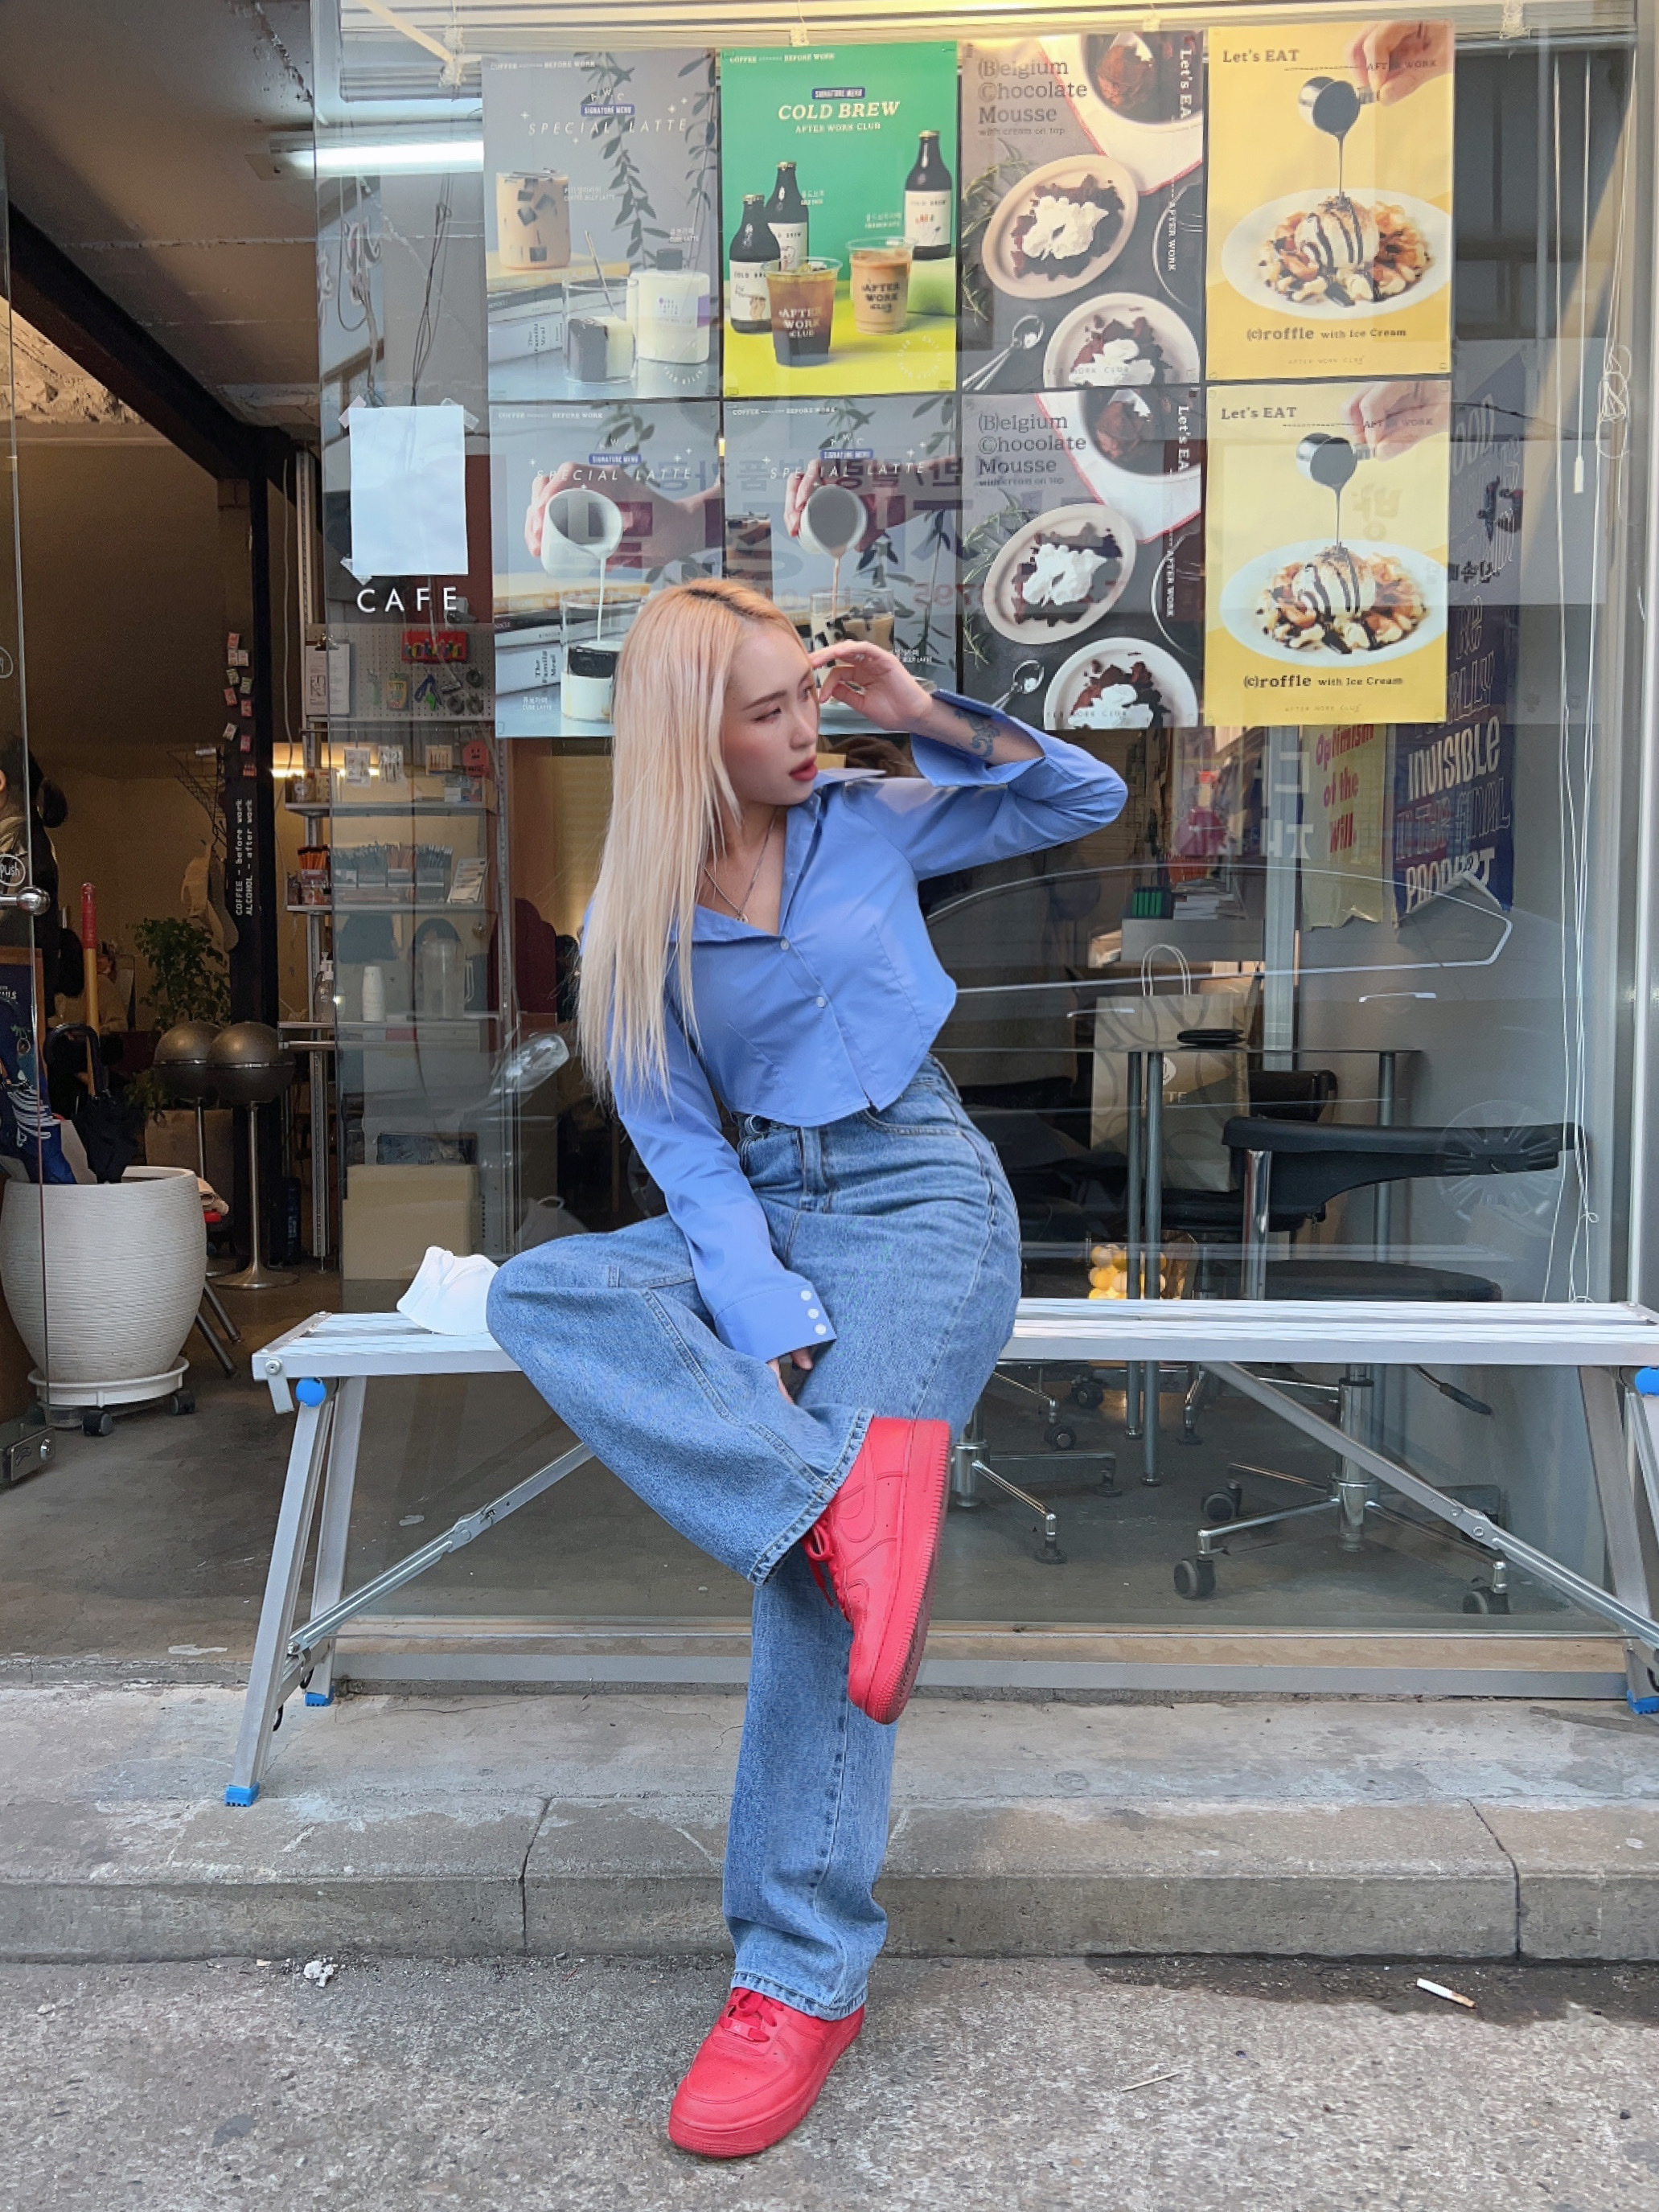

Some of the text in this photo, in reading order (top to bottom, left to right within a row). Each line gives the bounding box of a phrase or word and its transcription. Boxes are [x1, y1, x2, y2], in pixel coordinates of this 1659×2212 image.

[729, 52, 835, 64] COFFEE BEFORE WORK
[1222, 48, 1300, 63] Let's EAT
[544, 60, 572, 69] BEFORE
[573, 60, 595, 68] WORK
[1180, 49, 1193, 120] Let's EA
[584, 106, 614, 115] SIGNATURE
[778, 101, 901, 121] COLD BREW
[978, 105, 1057, 124] Mousse
[528, 118, 687, 136] SPECIAL LATTE
[795, 122, 881, 133] AFTER WORK CLUB
[860, 282, 901, 293] AFTER
[865, 293, 898, 302] WORK
[782, 318, 819, 330] WORK
[788, 330, 815, 339] CLUB
[1246, 326, 1406, 342] (c)roffle with Ice Cream
[498, 412, 525, 420] COFFEE
[552, 412, 580, 420] BEFORE
[1221, 405, 1297, 421] Let's EAT
[1178, 405, 1192, 471] Let's EA
[592, 455, 639, 464] SIGNATURE MENU
[868, 461, 925, 475] LATTE
[978, 458, 1057, 476] Mousse
[536, 467, 692, 482] SPECIAL LATTE
[356, 586, 458, 614] CAFE
[1242, 674, 1404, 689] (c)roffle with Ice Cream
[1316, 724, 1374, 772] Optimism
[1408, 715, 1500, 801] INVISIBLE
[1323, 765, 1359, 808] of the
[235, 798, 243, 824] work
[245, 798, 253, 824] work
[235, 829, 243, 864] before
[245, 828, 253, 859] after
[235, 880, 243, 916] COFFEE
[245, 875, 253, 916] ALCOHOL
